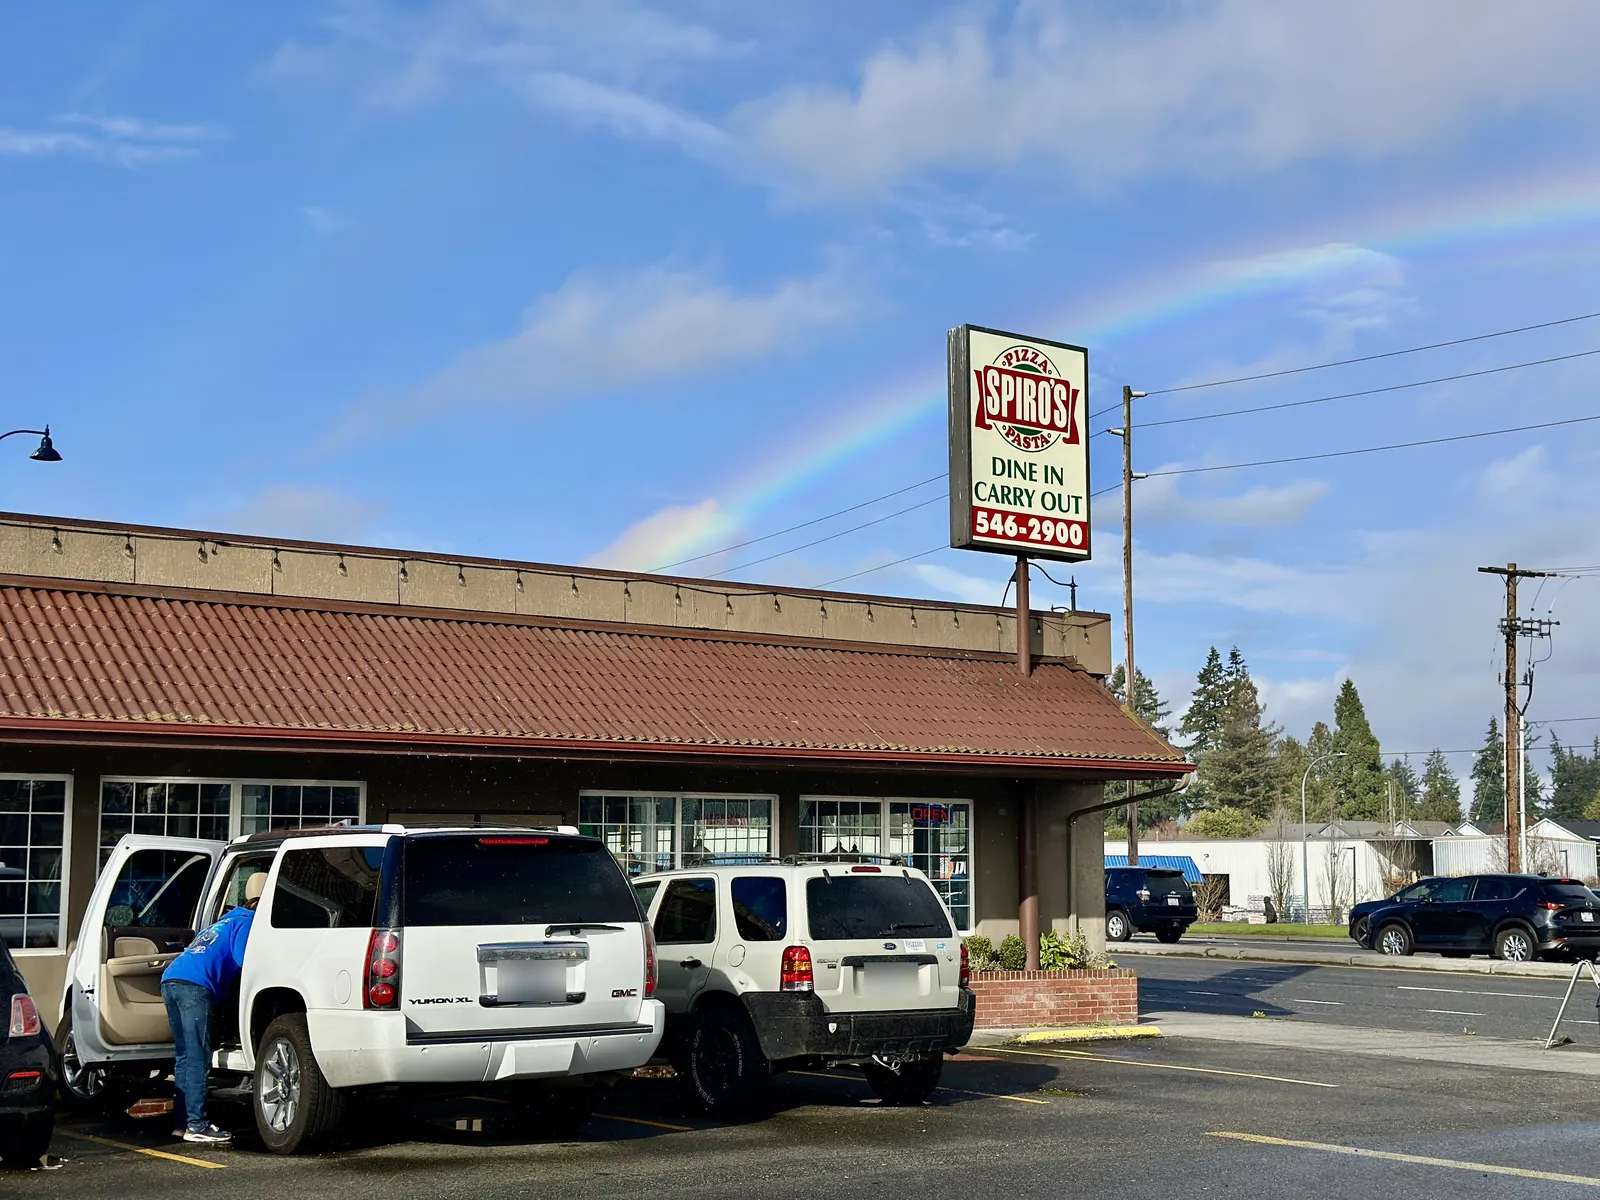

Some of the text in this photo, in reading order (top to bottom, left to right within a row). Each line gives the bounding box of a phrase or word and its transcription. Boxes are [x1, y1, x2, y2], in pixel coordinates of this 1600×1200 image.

[1004, 349, 1048, 373] PIZZA
[986, 368, 1068, 429] SPIRO'S
[1004, 425, 1051, 449] PASTA
[992, 456, 1064, 486] DINE IN
[974, 481, 1083, 514] CARRY OUT
[976, 511, 1083, 546] 546-2900
[912, 807, 950, 822] OPEN
[611, 988, 638, 998] GMC
